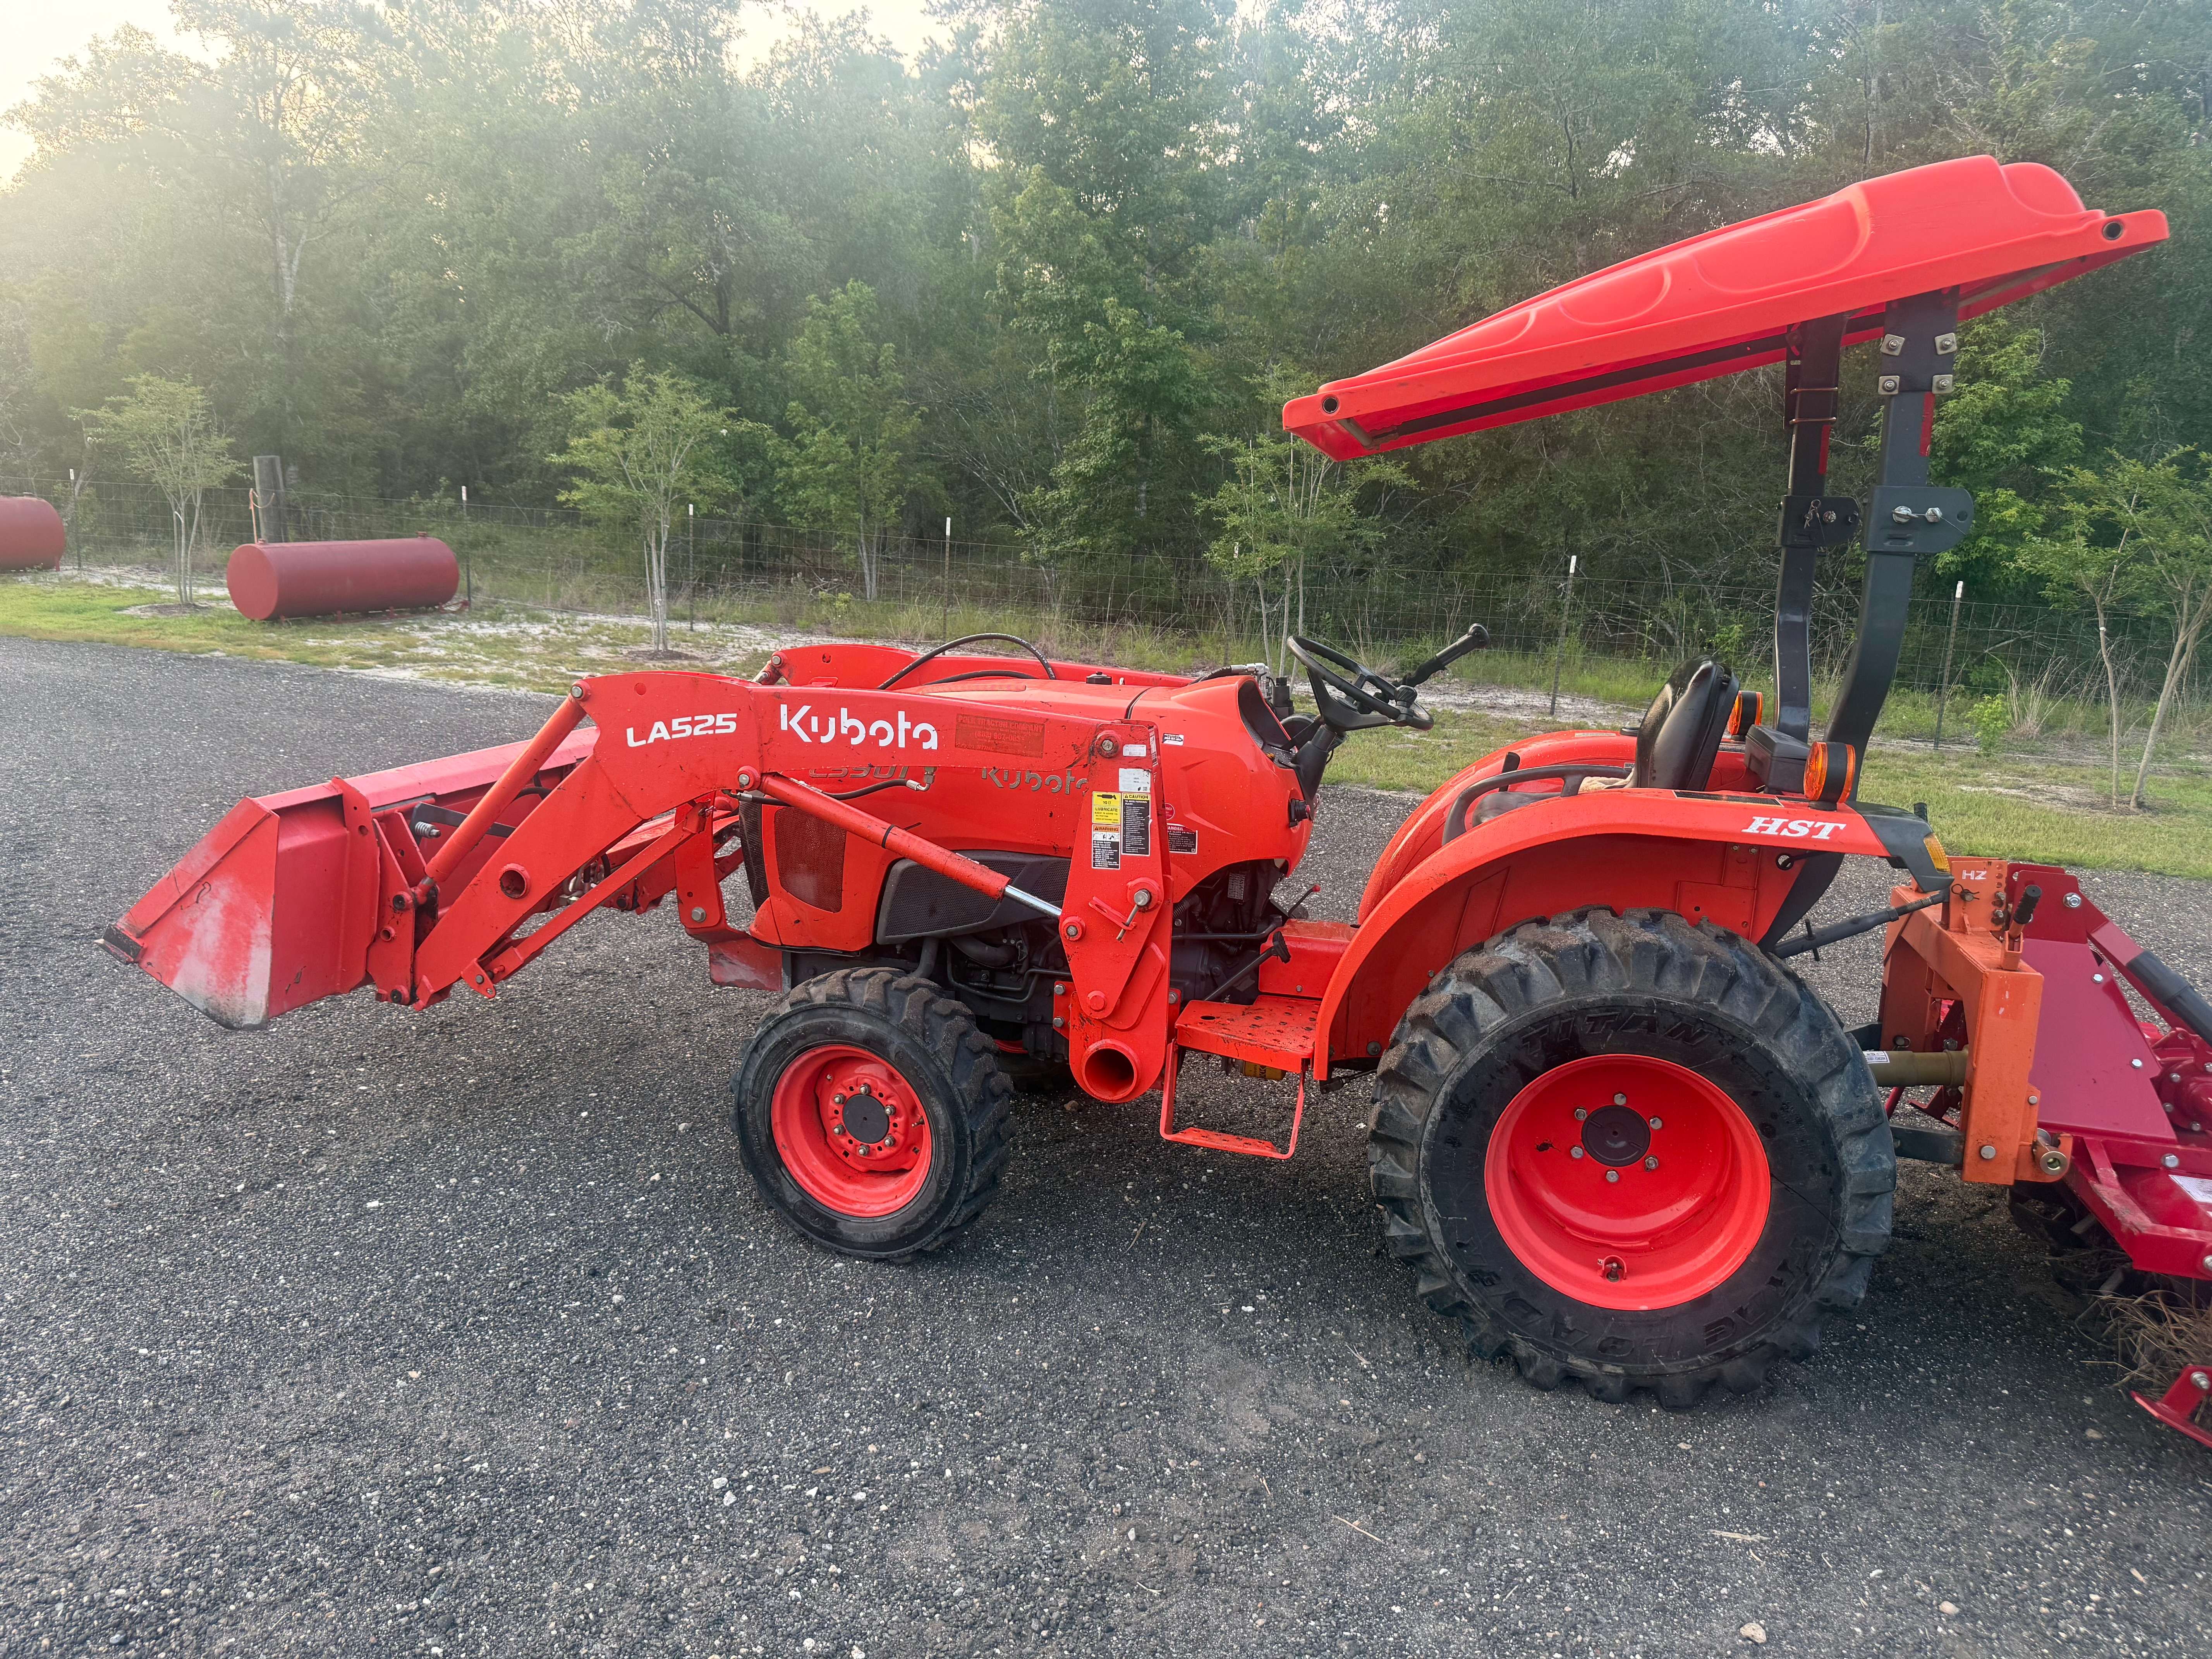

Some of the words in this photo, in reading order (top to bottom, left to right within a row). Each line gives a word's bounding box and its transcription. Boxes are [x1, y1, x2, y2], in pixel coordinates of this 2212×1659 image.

[626, 712, 738, 747] LA525
[780, 704, 939, 750] Kubota
[1741, 816, 1846, 840] HST
[1521, 1012, 1713, 1055] TITAN
